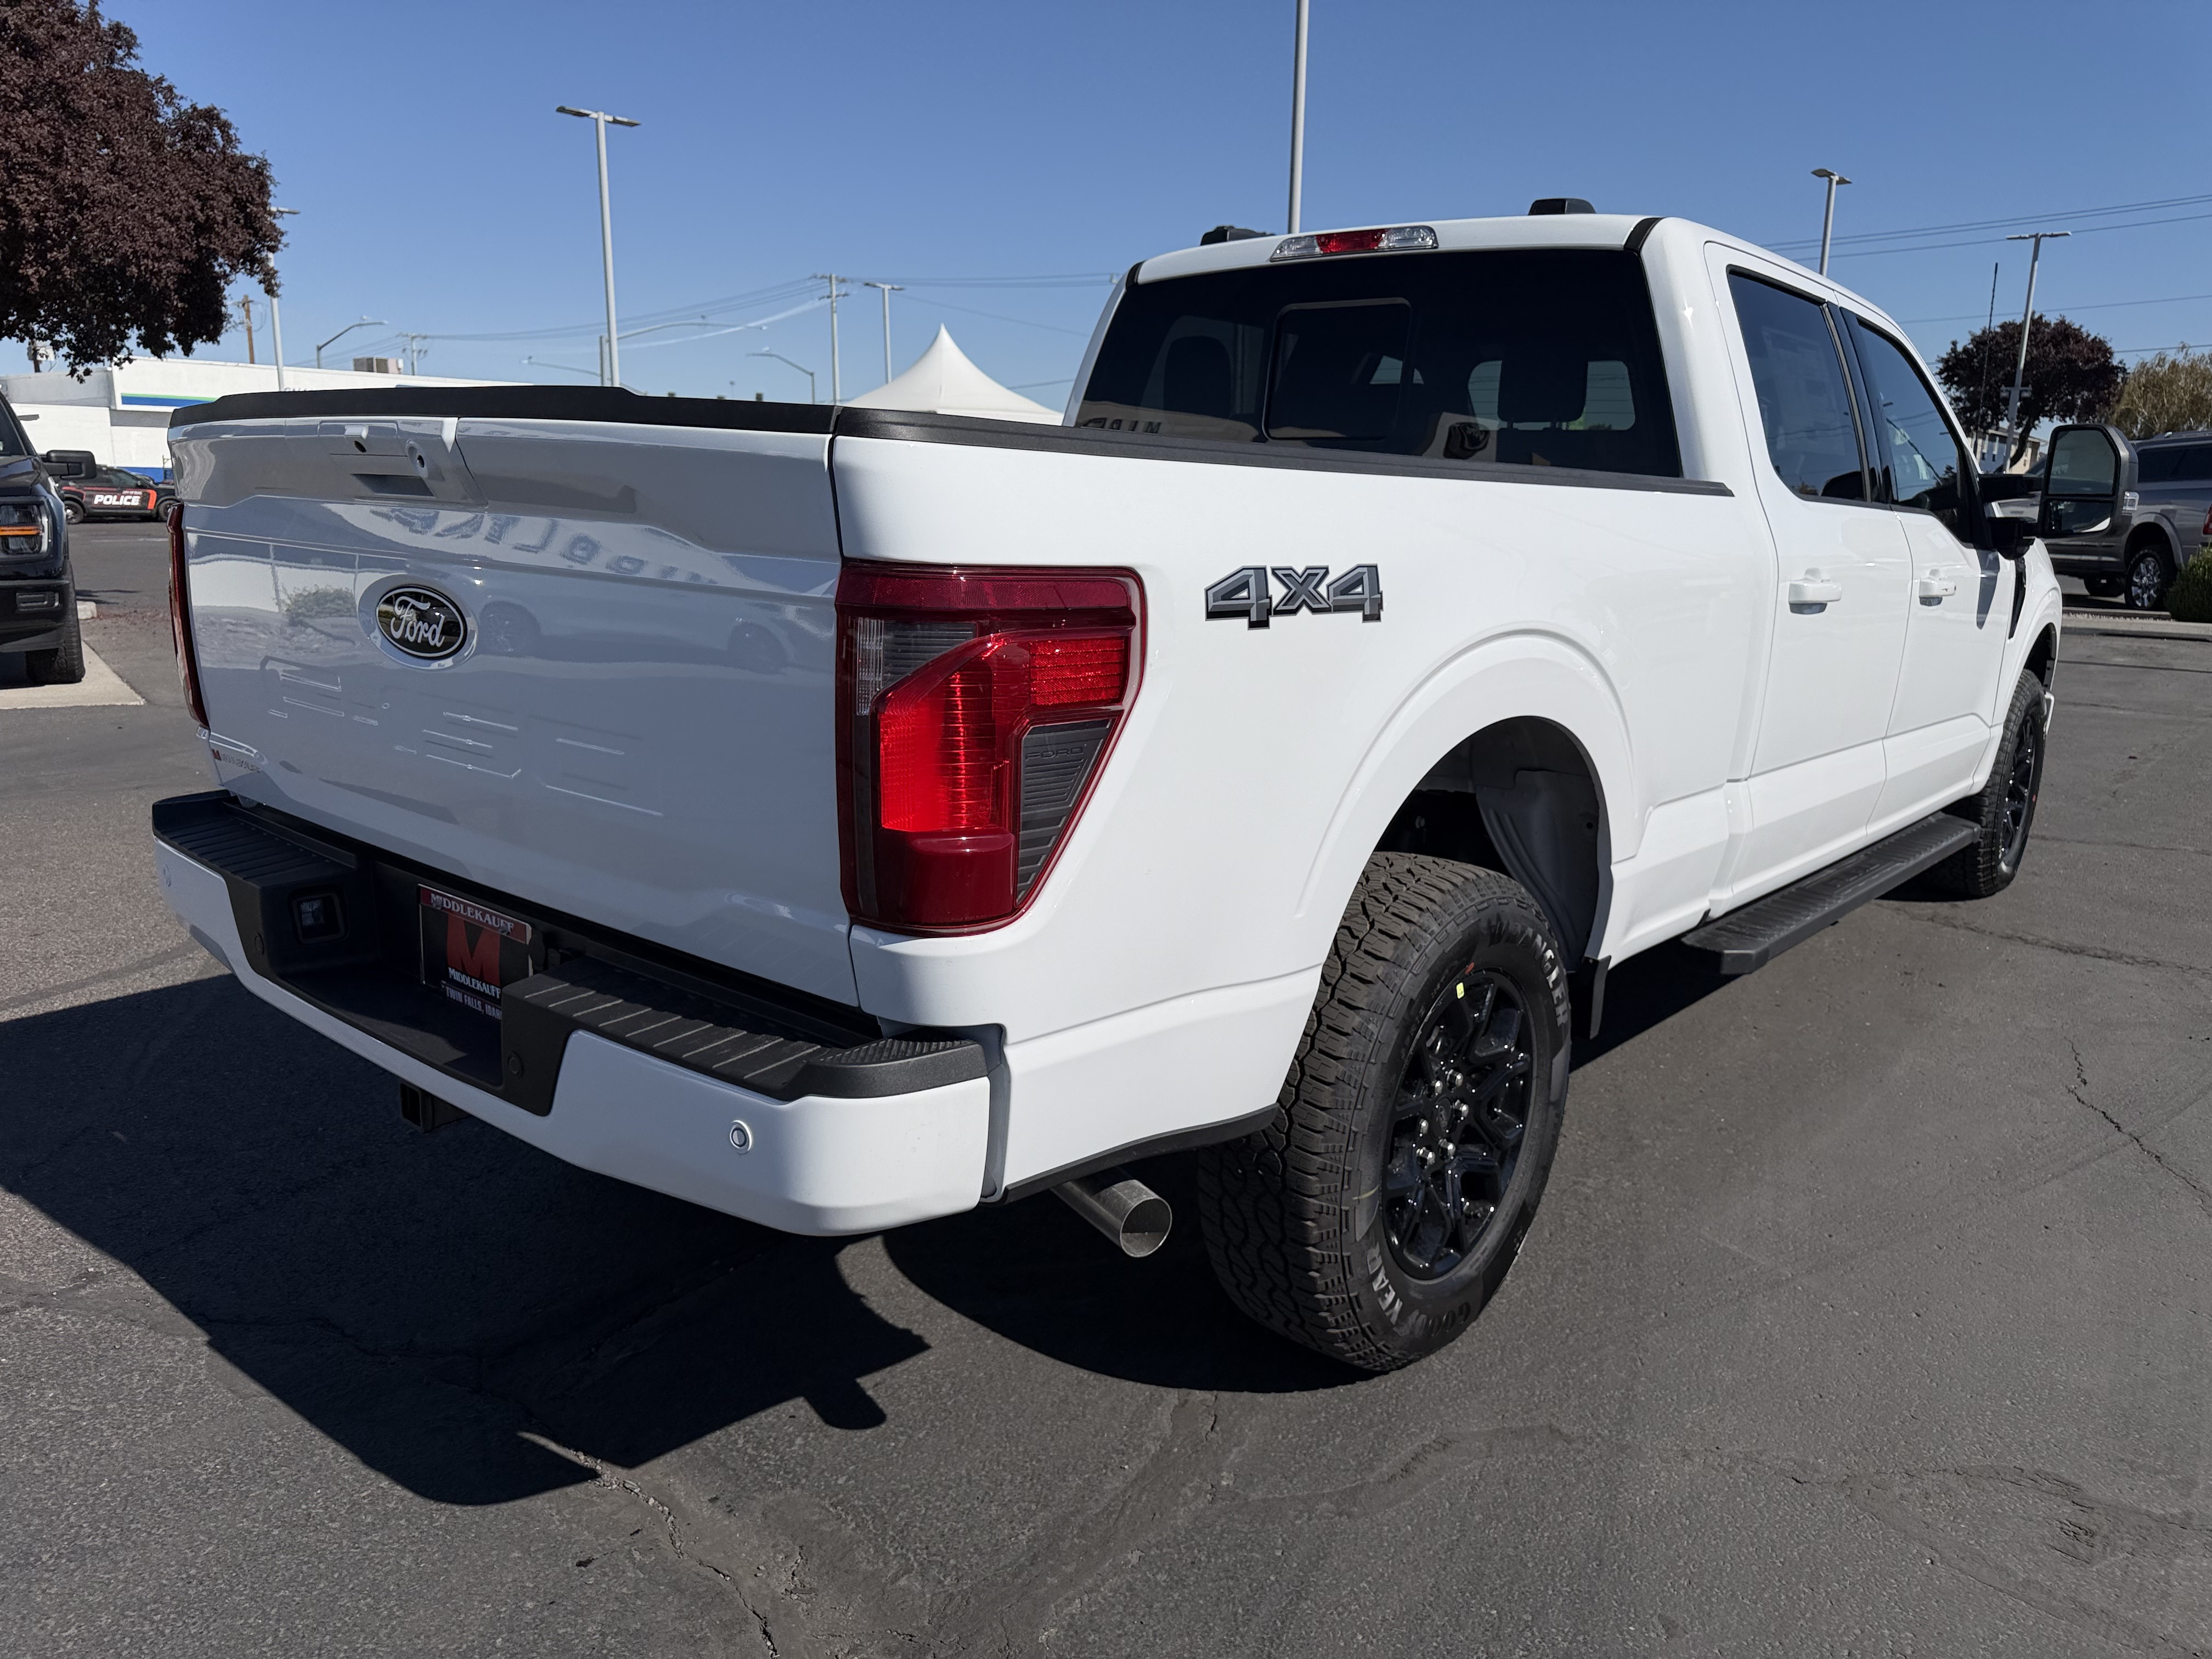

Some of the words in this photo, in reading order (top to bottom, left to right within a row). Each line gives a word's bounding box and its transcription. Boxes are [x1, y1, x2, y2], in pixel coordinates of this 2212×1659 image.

[94, 494, 141, 506] POLICE
[391, 596, 445, 648] Ford
[1025, 747, 1084, 761] FORD
[448, 966, 501, 999] MIDDLEKAUFF
[445, 986, 463, 1003] TWIN
[485, 1003, 502, 1020] IDAH
